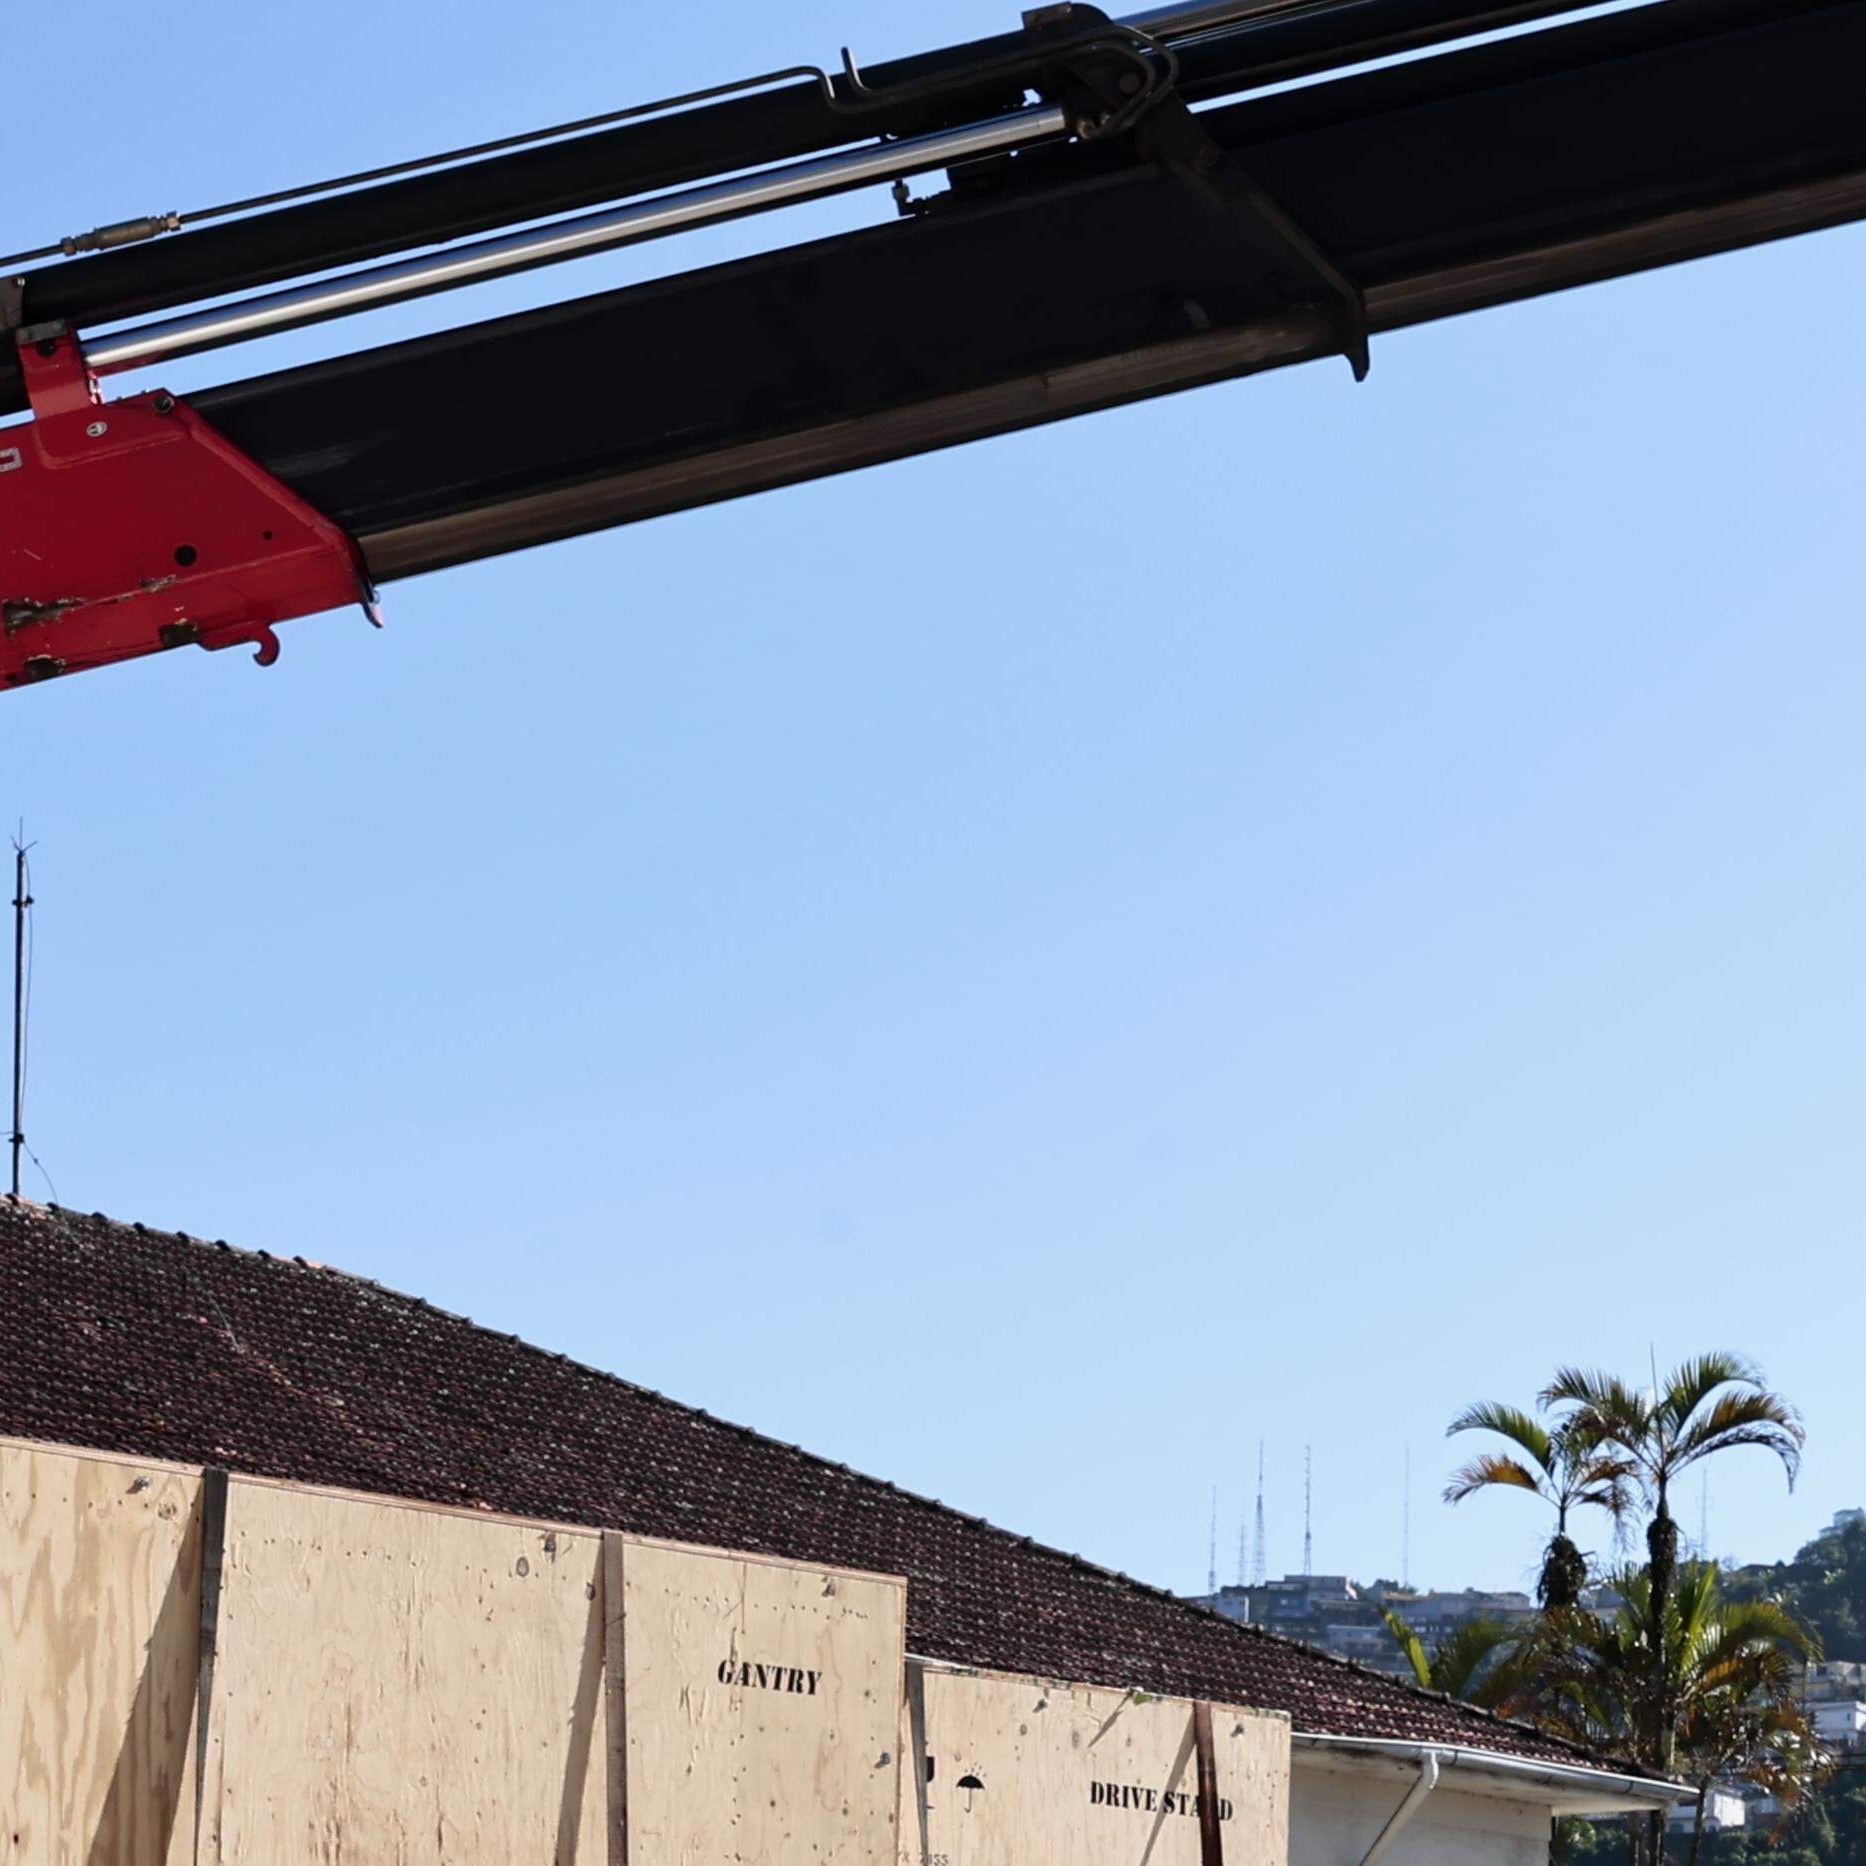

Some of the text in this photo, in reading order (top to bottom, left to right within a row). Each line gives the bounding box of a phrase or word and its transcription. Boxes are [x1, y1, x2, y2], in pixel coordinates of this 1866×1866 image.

[717, 1659, 823, 1695] GANTRY
[1090, 1781, 1234, 1821] DRIVE STAD
